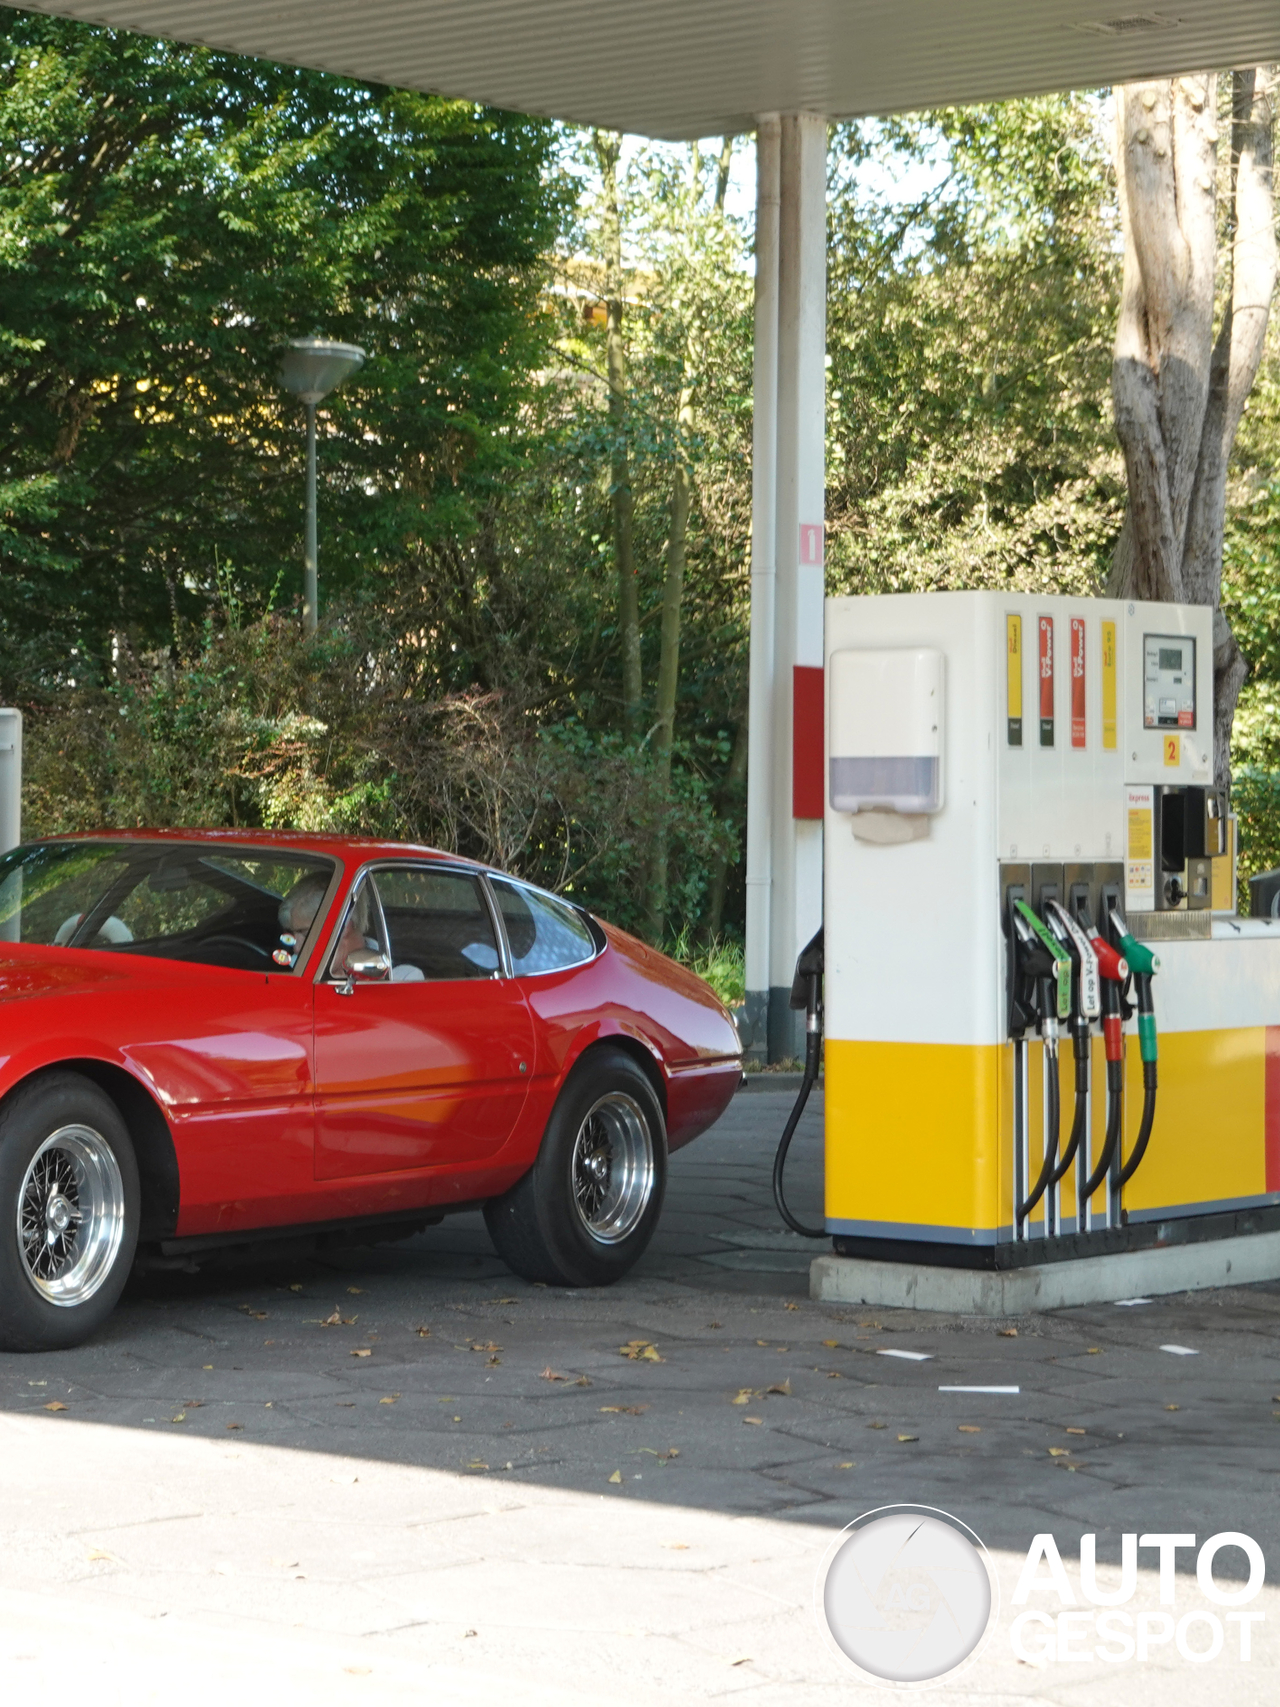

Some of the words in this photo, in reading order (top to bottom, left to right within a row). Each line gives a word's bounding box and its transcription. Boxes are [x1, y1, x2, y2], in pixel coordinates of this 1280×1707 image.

[808, 528, 816, 560] 1
[1168, 741, 1176, 760] 2
[1078, 936, 1095, 976] V-Power
[1063, 971, 1069, 986] op
[1088, 979, 1095, 991] op
